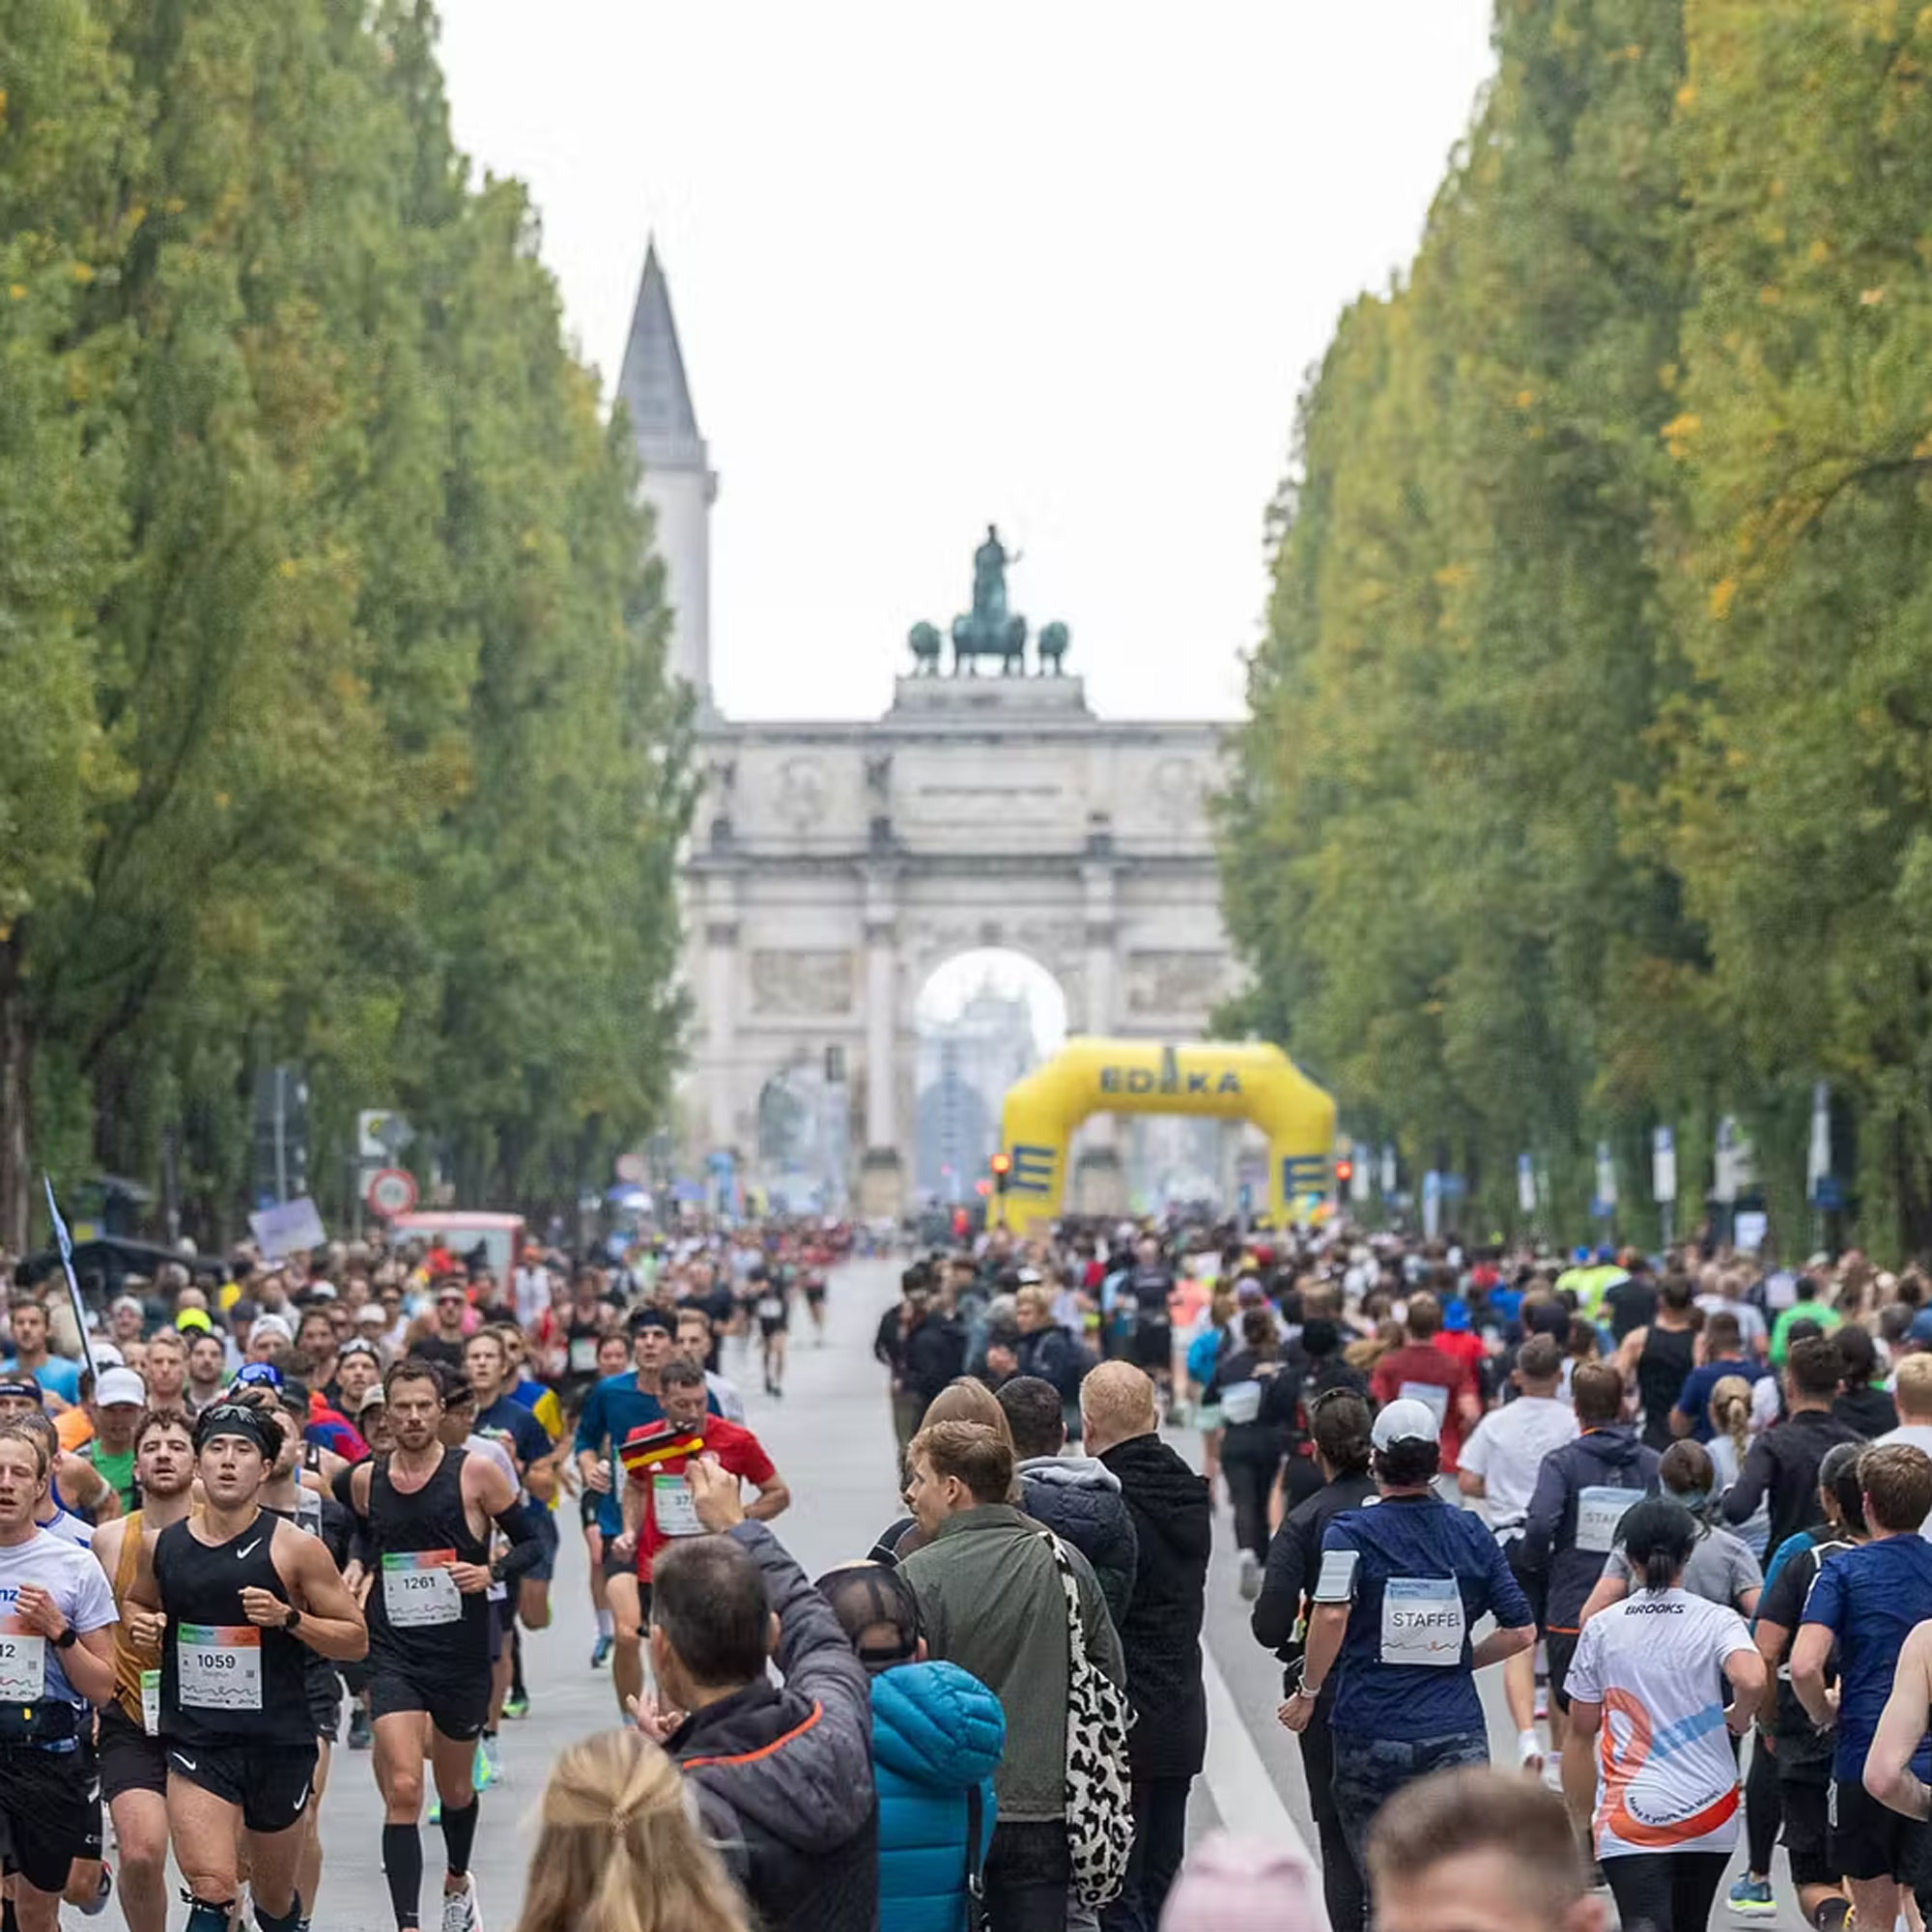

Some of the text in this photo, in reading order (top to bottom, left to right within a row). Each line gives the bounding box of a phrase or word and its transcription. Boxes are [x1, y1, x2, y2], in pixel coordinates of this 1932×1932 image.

[1585, 1512, 1618, 1522] STAF
[404, 1576, 436, 1590] 1261
[0, 1589, 18, 1602] nz
[1625, 1604, 1686, 1615] BROOKS
[0, 1644, 16, 1659] 12
[197, 1654, 237, 1669] 1059
